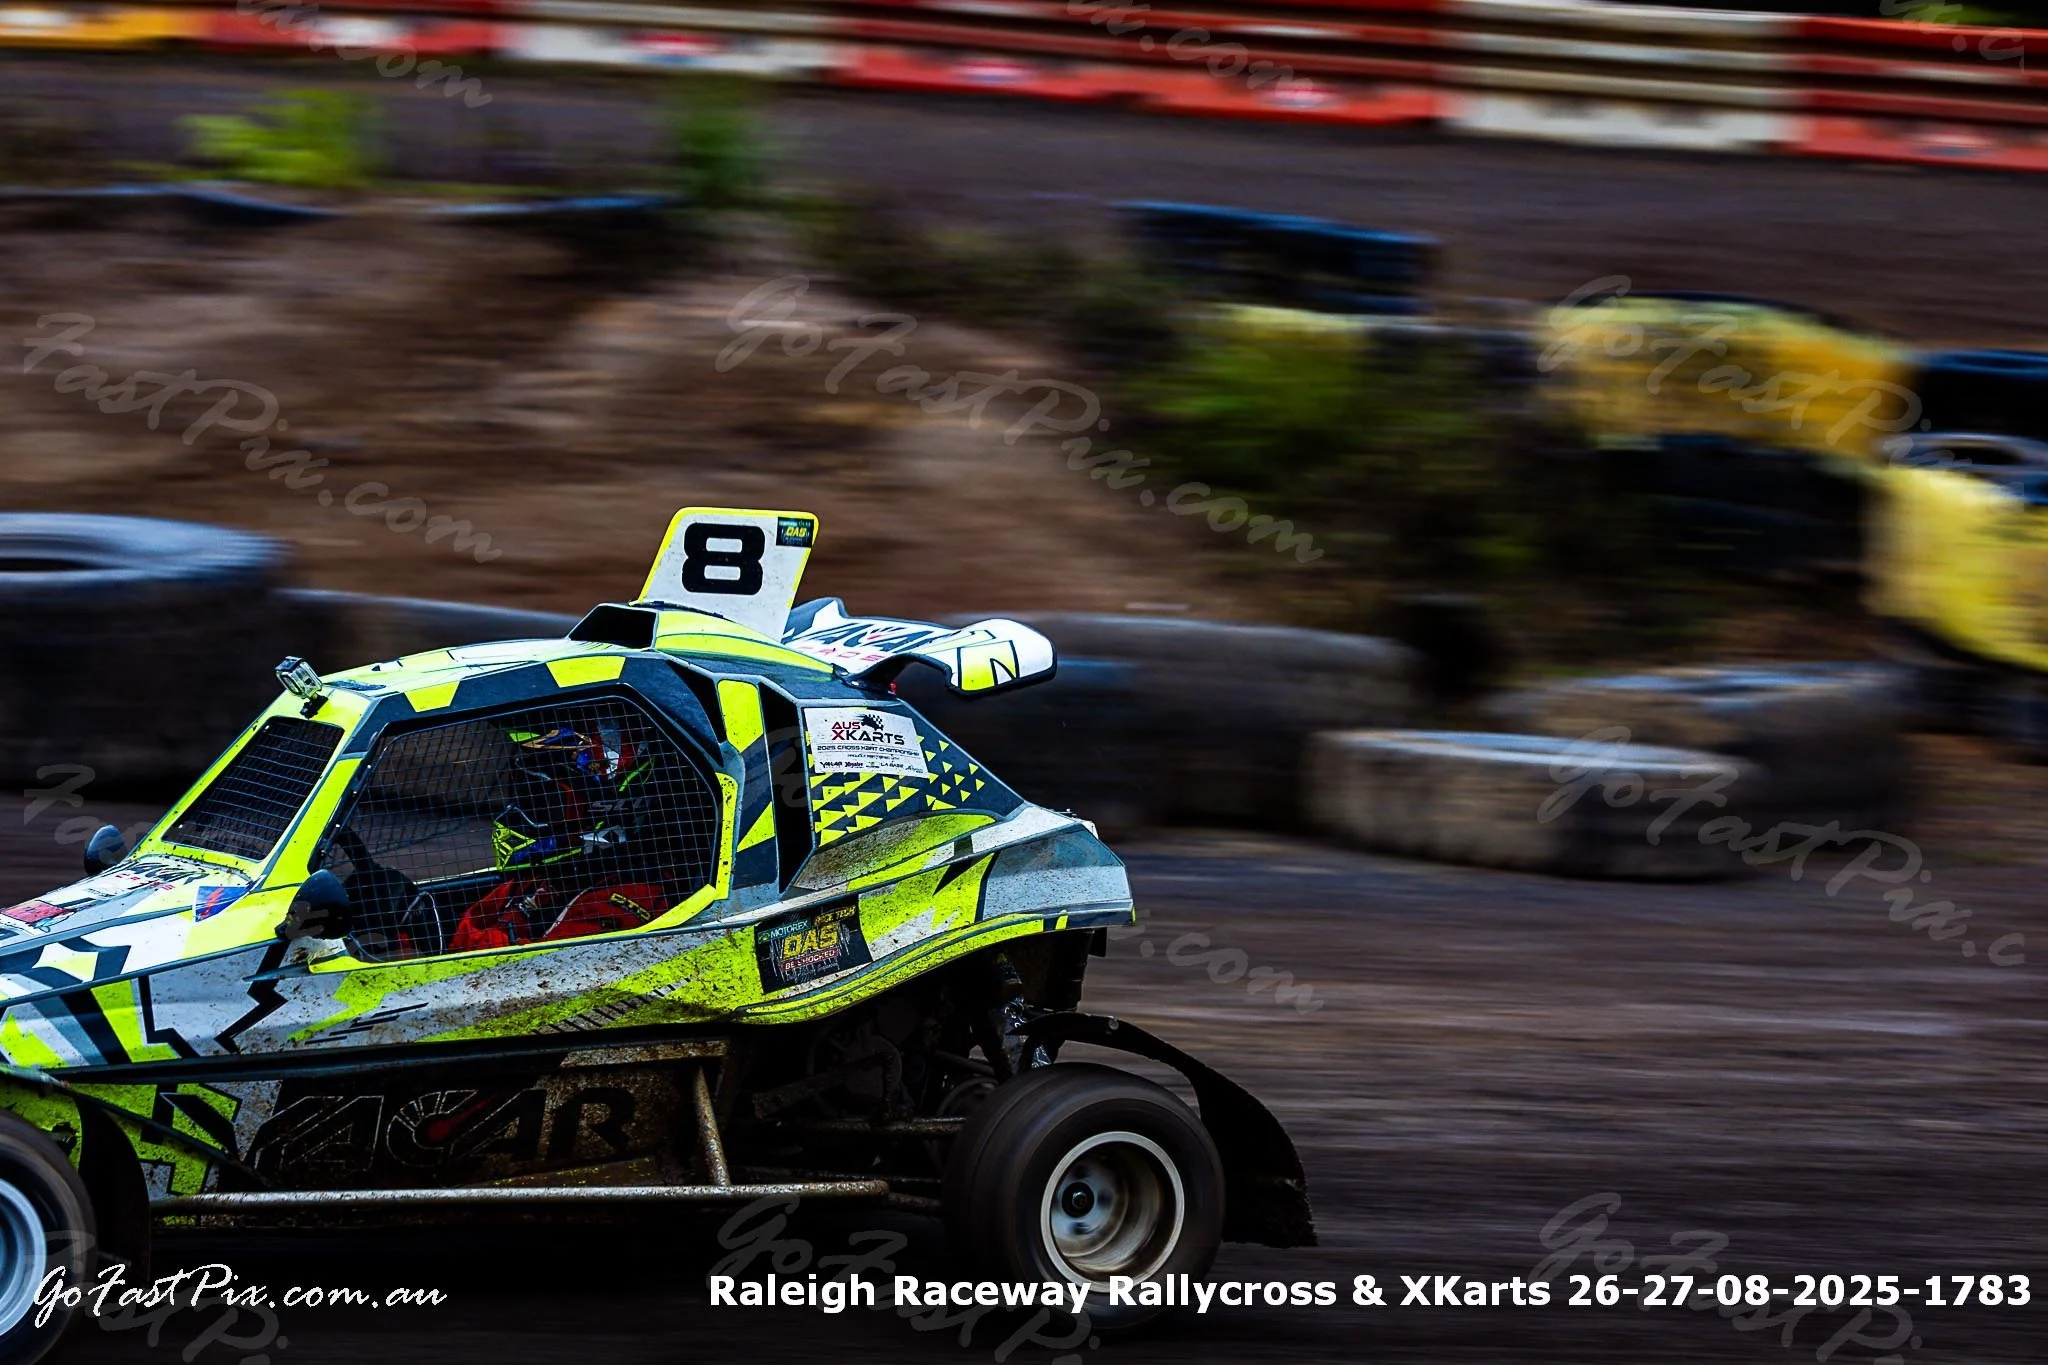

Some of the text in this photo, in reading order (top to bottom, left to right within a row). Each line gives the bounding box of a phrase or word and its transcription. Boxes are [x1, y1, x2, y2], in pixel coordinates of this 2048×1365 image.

[682, 522, 766, 595] 8
[832, 721, 861, 730] AUS
[832, 729, 905, 746] XKARTS
[769, 919, 808, 939] MOTOREX
[785, 949, 835, 970] BE SHOCKED
